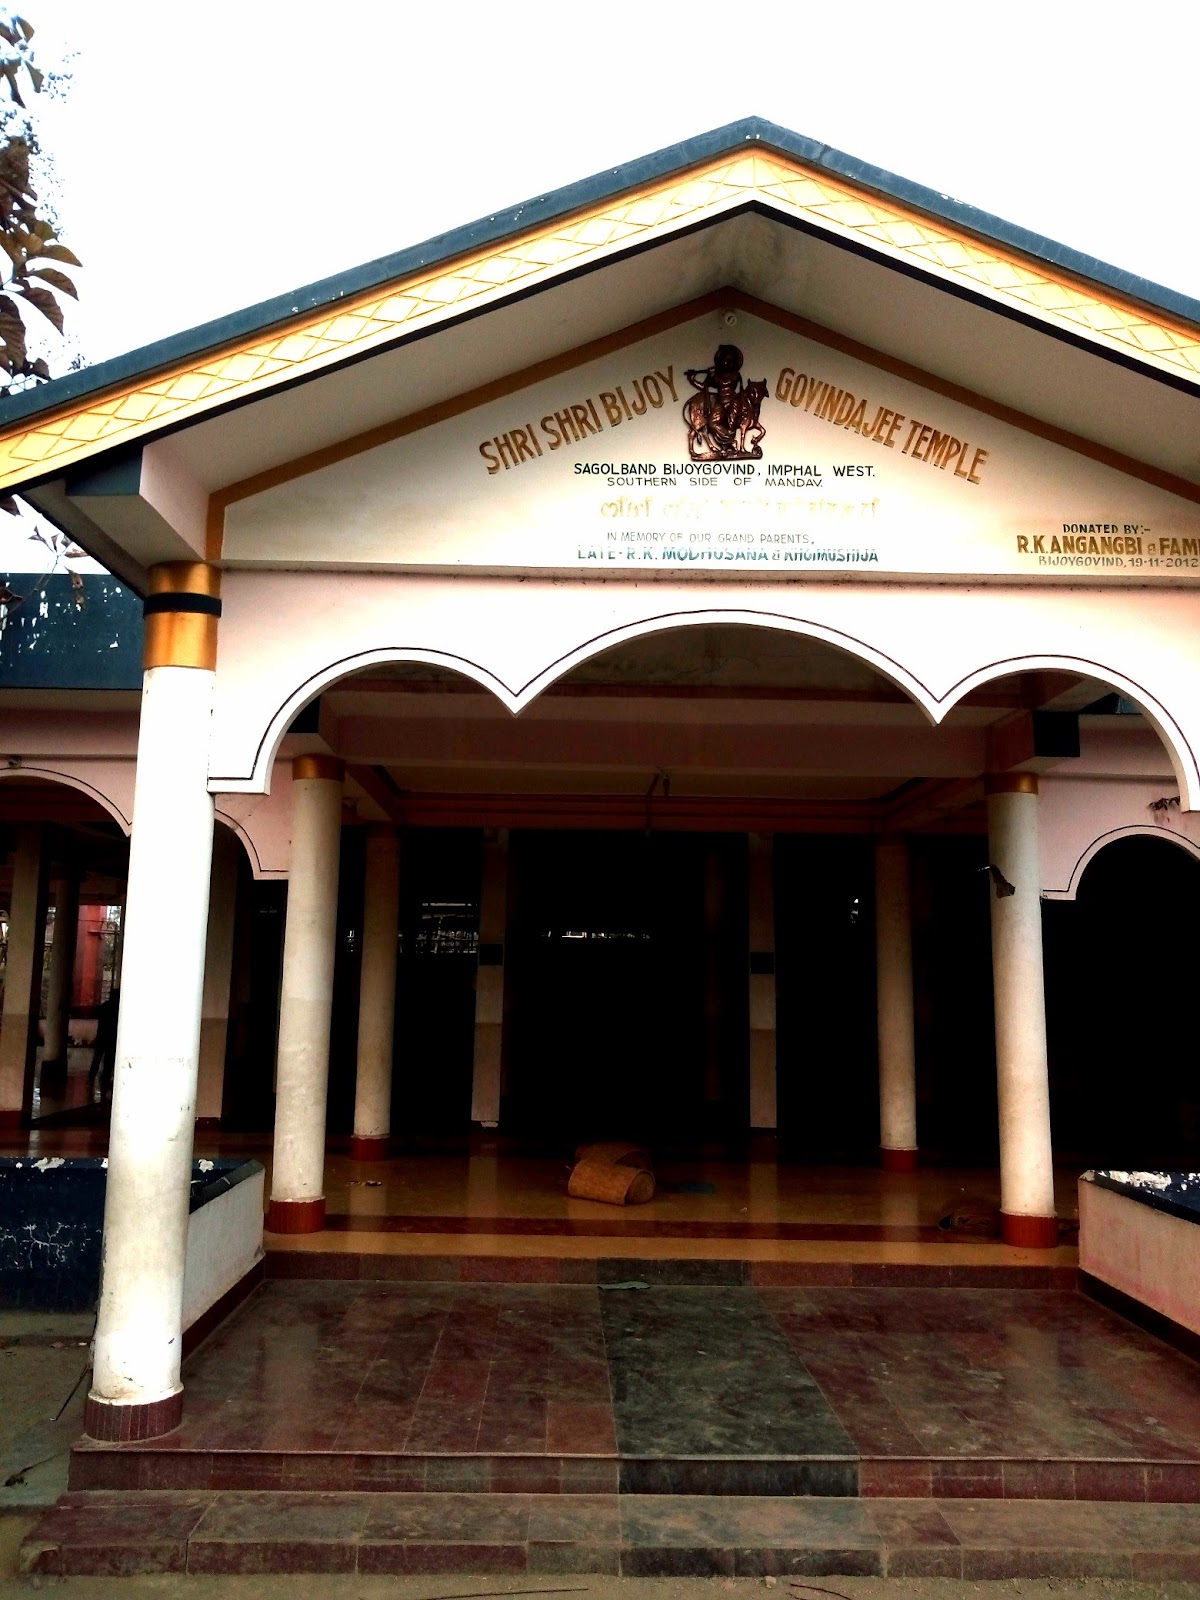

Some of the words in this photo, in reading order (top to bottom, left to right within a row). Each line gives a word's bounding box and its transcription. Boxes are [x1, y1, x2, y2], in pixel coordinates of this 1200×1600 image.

[479, 424, 543, 475] SHRI
[540, 398, 604, 450] SHRI
[600, 365, 679, 428] BIJOY
[775, 367, 906, 449] GOVINDAJEE
[901, 419, 989, 485] TEMPLE
[574, 463, 657, 475] SAGOLBAND
[664, 463, 761, 477] BIJOYGOVIND,
[768, 464, 822, 477] IMPHAL
[833, 465, 876, 477] WEST.
[607, 477, 677, 487] SOUTHERN
[689, 477, 718, 486] SIDE
[733, 477, 752, 486] OF
[1063, 524, 1118, 534] DONATED
[607, 532, 617, 541] IN
[620, 532, 666, 542] MEMORY
[670, 533, 683, 541] OF
[689, 533, 712, 543] OUR
[718, 533, 754, 543] GRAND
